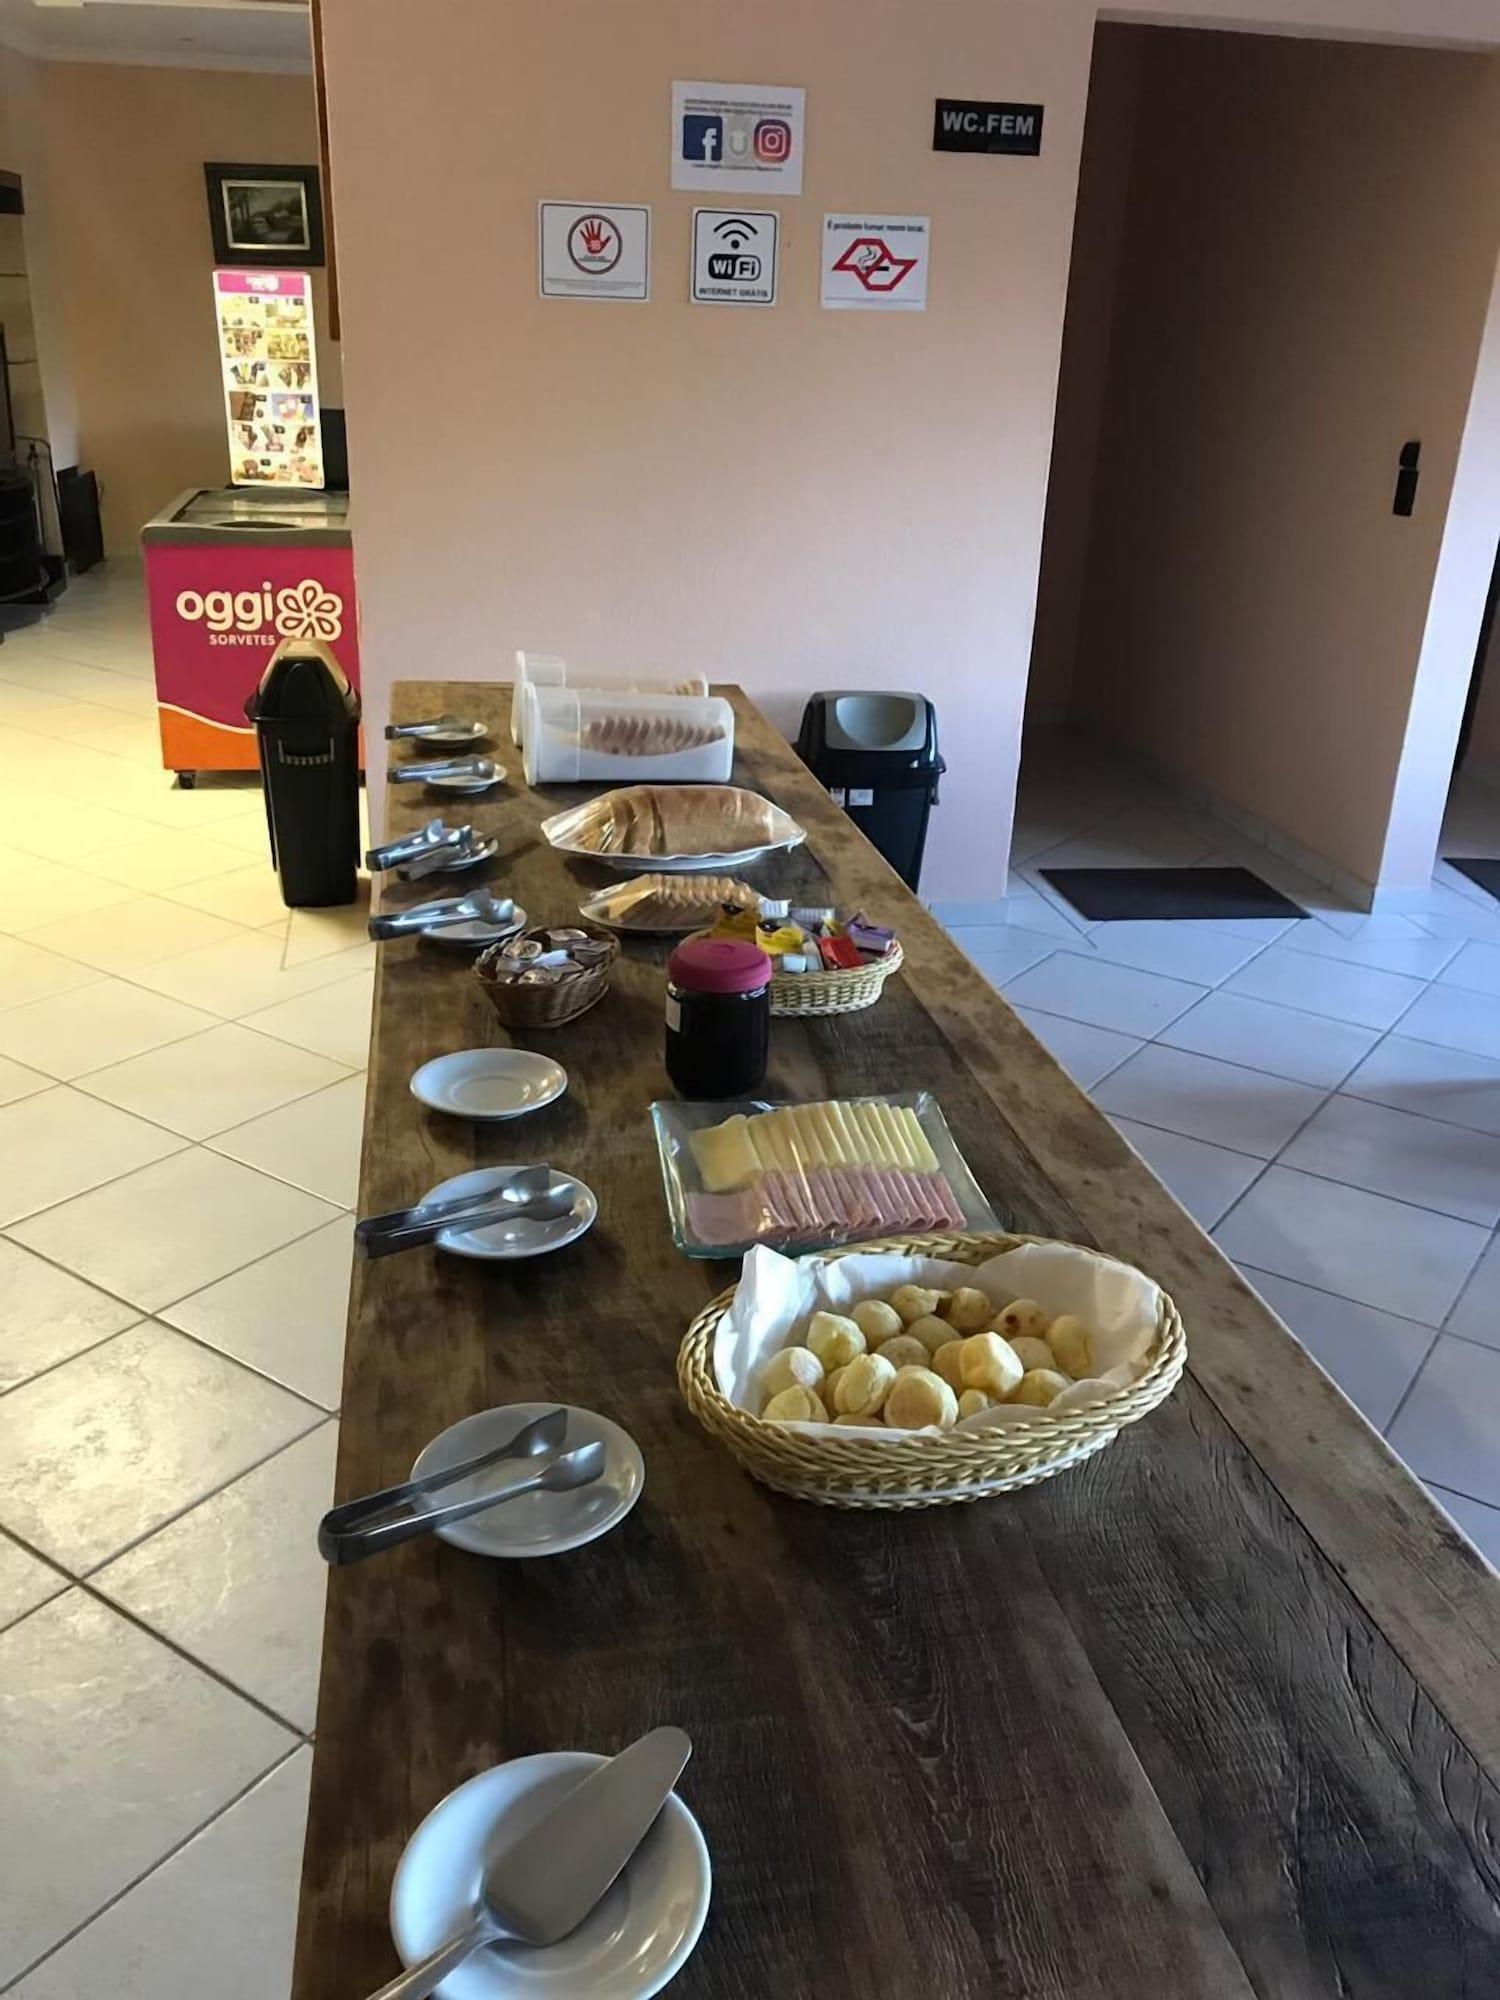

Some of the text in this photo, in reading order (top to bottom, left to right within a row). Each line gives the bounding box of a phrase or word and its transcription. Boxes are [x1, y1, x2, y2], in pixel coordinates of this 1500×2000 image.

[942, 111, 1035, 136] WC.FEM
[699, 287, 737, 297] INTERNET
[176, 581, 274, 631] oggi
[209, 633, 276, 646] SORVETES
